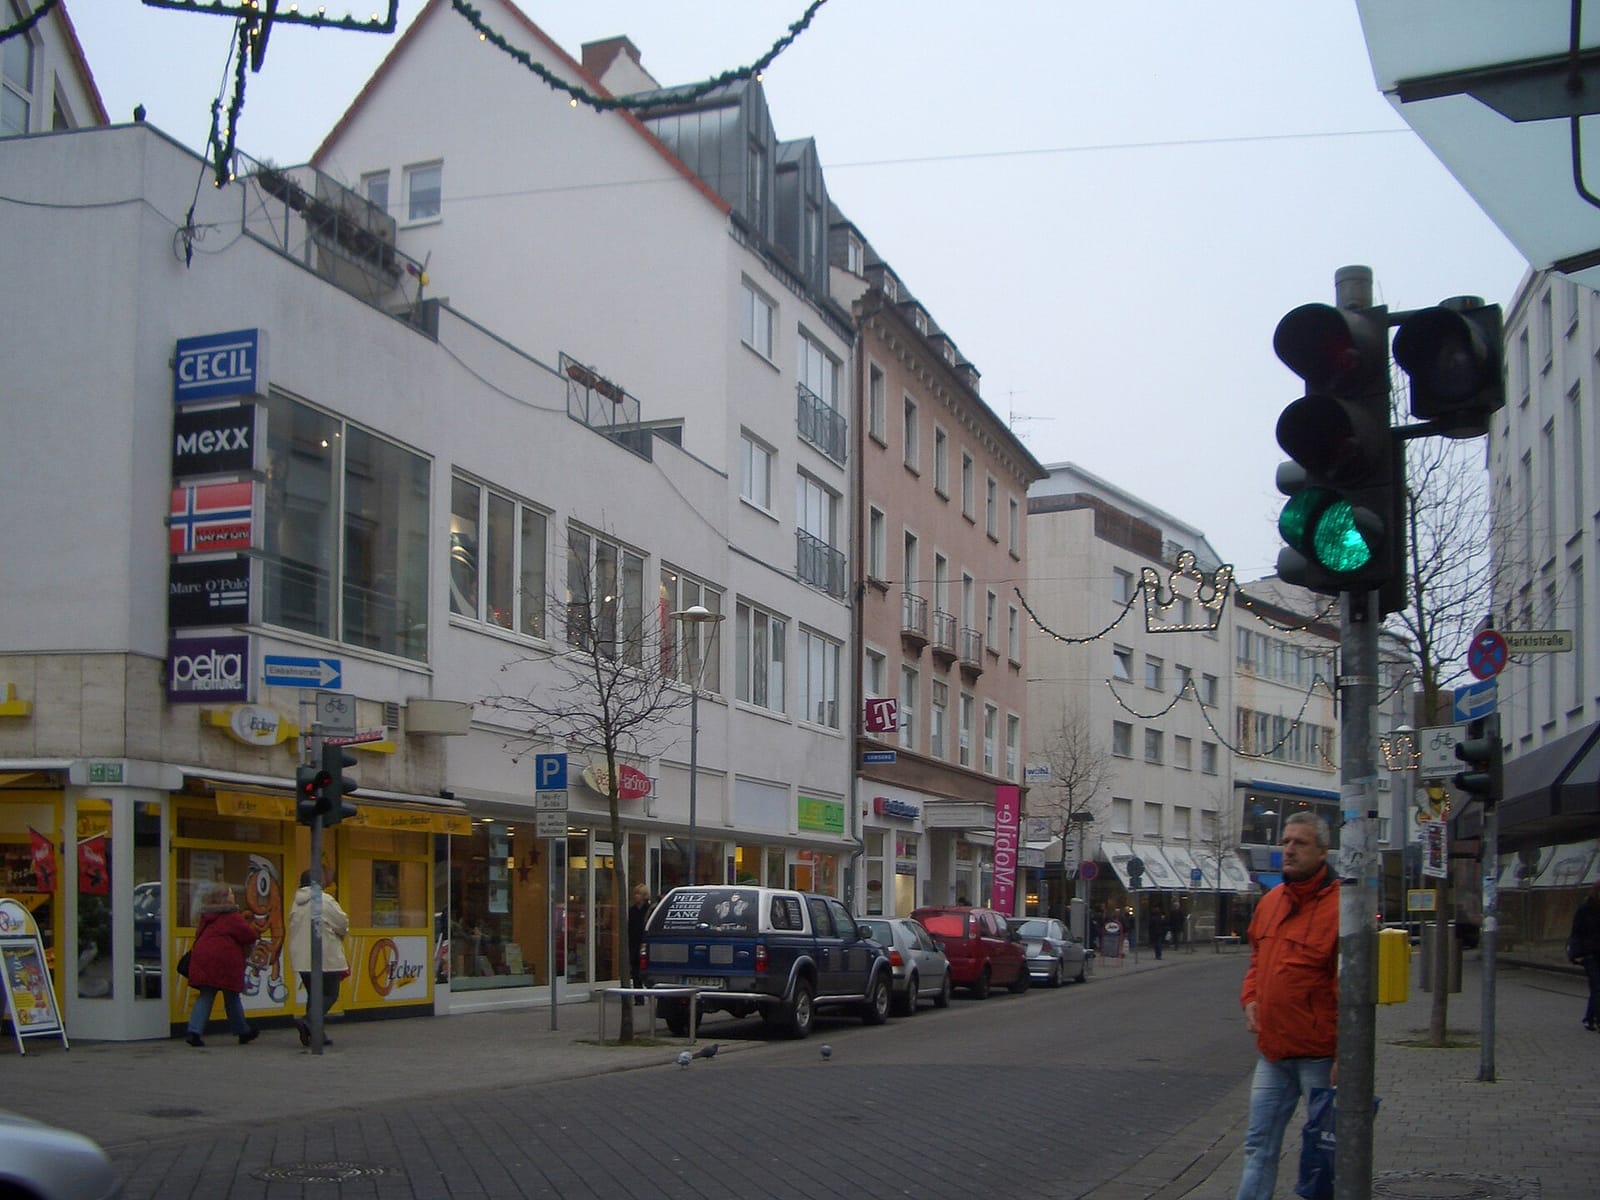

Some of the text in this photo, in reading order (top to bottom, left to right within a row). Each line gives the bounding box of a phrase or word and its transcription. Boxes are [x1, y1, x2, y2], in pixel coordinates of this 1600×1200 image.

[179, 350, 252, 382] CECIL
[170, 581, 202, 595] Marc
[174, 649, 241, 691] petra
[542, 758, 560, 786] P
[388, 960, 424, 980] Ecker
